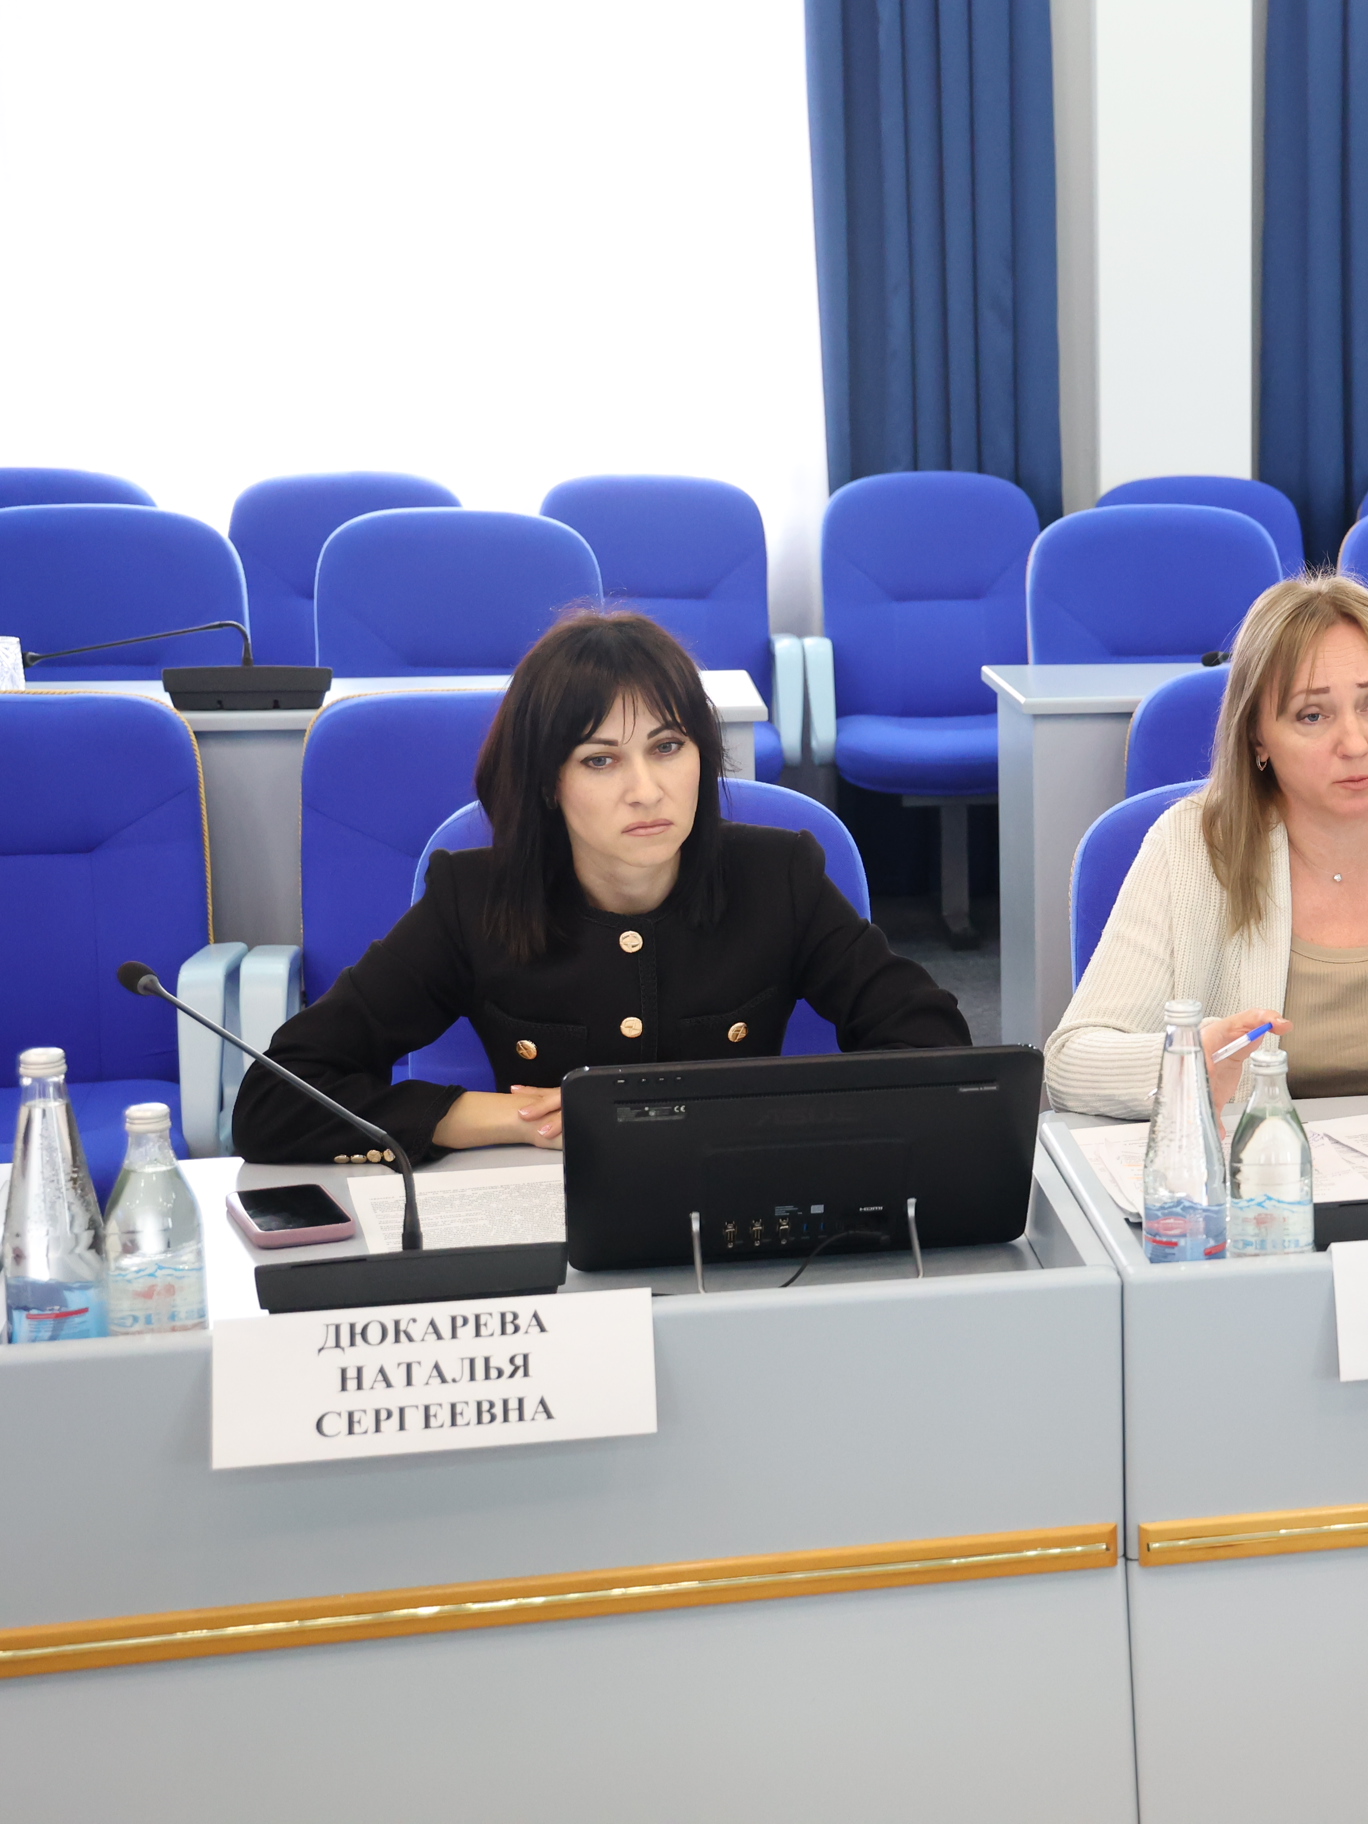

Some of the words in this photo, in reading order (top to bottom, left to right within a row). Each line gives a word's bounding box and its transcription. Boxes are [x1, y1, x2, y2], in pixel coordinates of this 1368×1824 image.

[317, 1309, 549, 1356] ДЮКАРЕВА
[338, 1353, 532, 1393] НАТАЛЬЯ
[315, 1396, 556, 1438] СЕРГЕЕВНА
